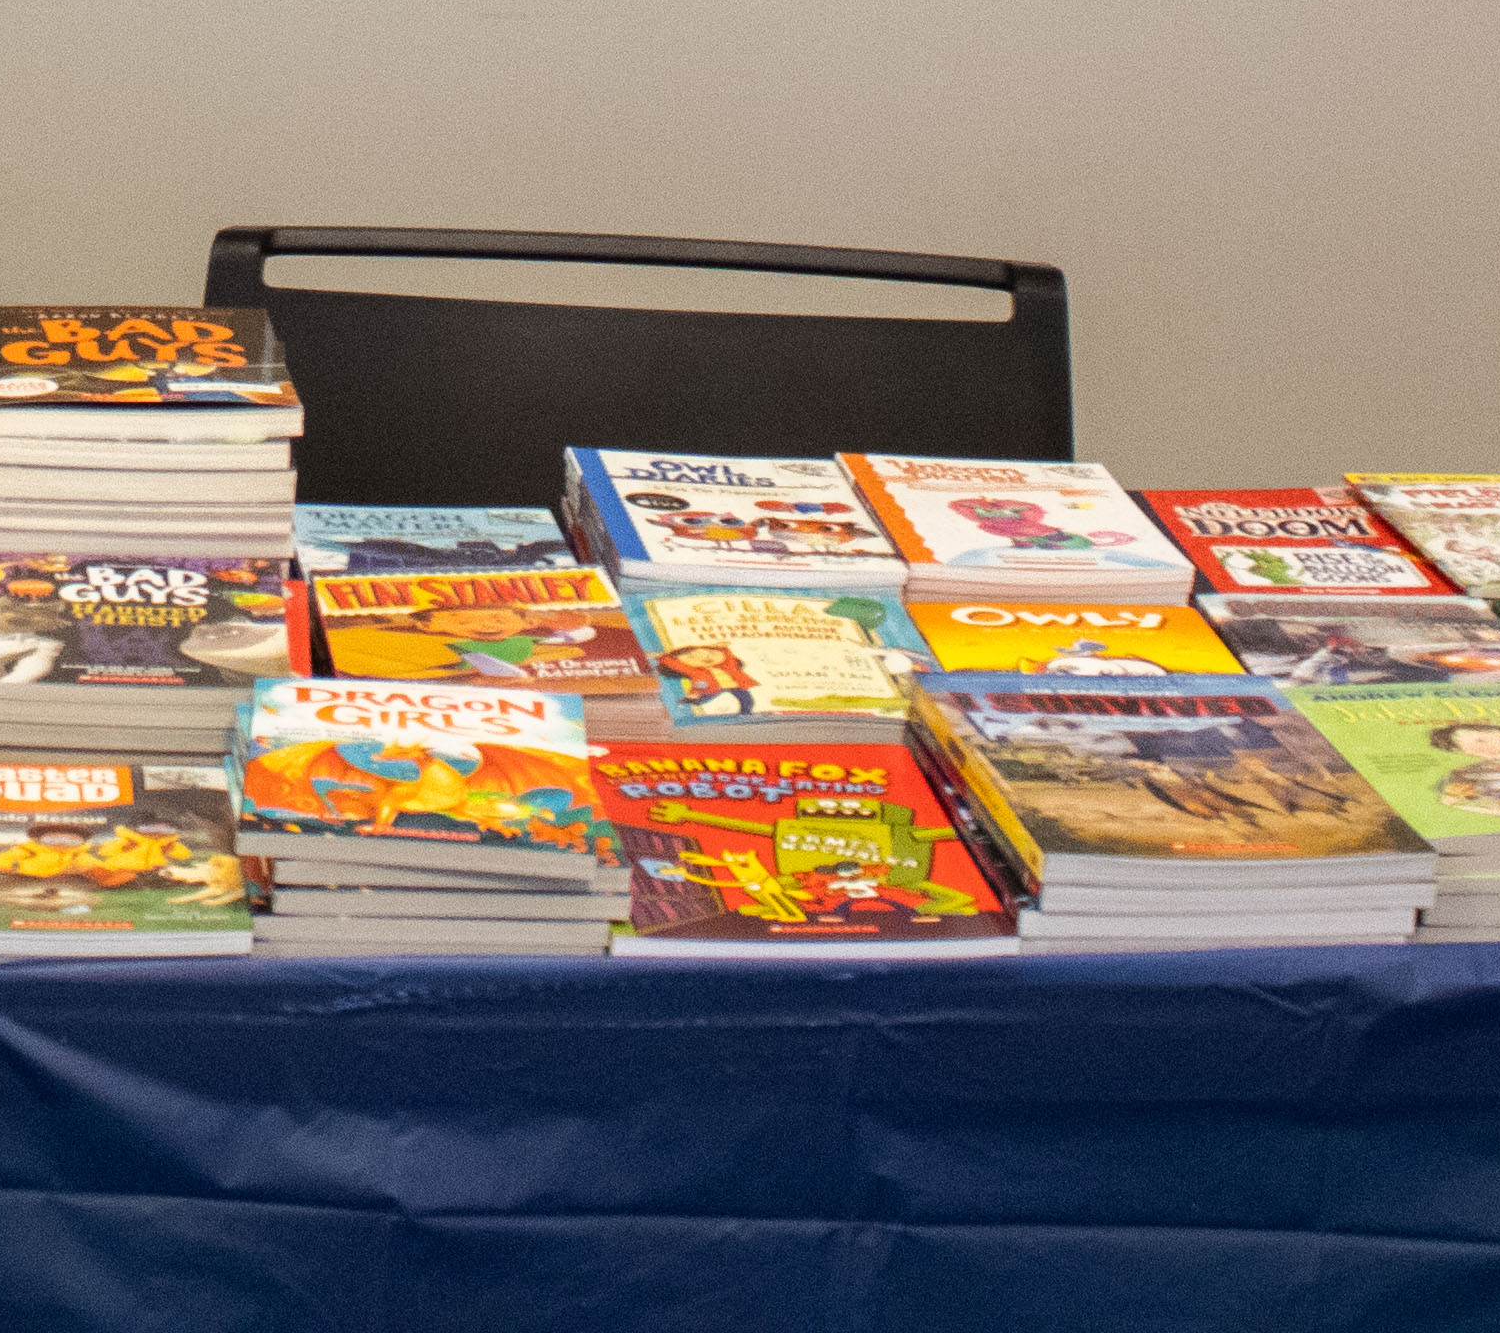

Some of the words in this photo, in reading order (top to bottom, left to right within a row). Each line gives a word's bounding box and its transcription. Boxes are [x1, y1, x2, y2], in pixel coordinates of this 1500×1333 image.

[39, 318, 233, 344] BAD
[0, 337, 247, 367] GUYS
[649, 459, 732, 475] OWL
[626, 468, 776, 489] DIARIES
[1193, 519, 1369, 538] DOOM
[1295, 552, 1351, 564] RISE
[86, 566, 207, 587] BAD
[58, 582, 208, 606] GUYS
[323, 579, 416, 609] FLAT
[417, 574, 592, 607] STANLEY
[71, 603, 207, 623] HAUNTED
[92, 614, 183, 629] HEIST
[951, 607, 1167, 629] OWLY
[295, 686, 545, 722] DRAGON
[986, 693, 1278, 718] SURVIVED
[316, 703, 523, 738] GIRLS
[599, 758, 767, 778] BANANA
[778, 761, 888, 785] FOX
[618, 783, 796, 803] ROBOT
